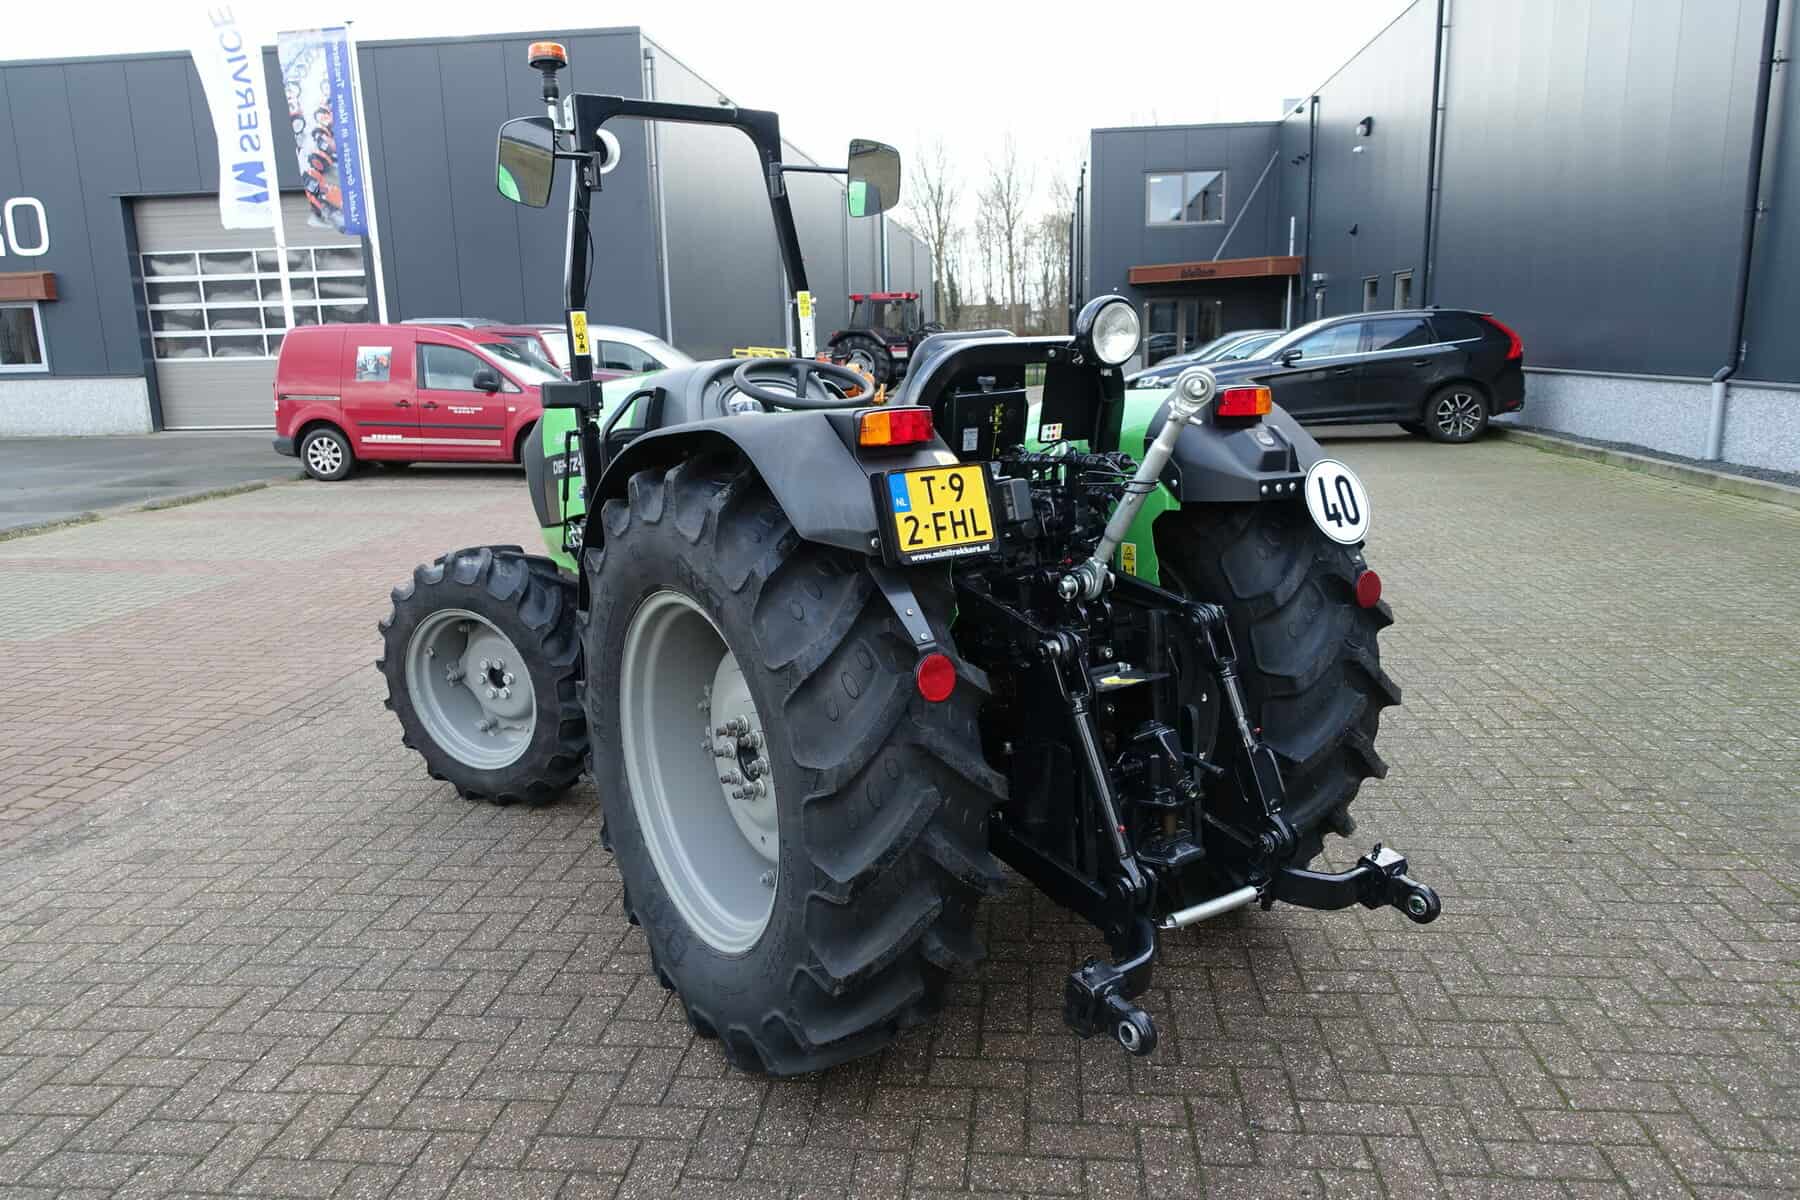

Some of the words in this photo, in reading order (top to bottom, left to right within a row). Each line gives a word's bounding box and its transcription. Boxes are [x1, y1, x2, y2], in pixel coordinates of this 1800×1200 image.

[0, 197, 49, 256] O
[895, 497, 907, 506] NL
[1318, 475, 1360, 528] 40
[904, 508, 986, 545] 2-FHL
